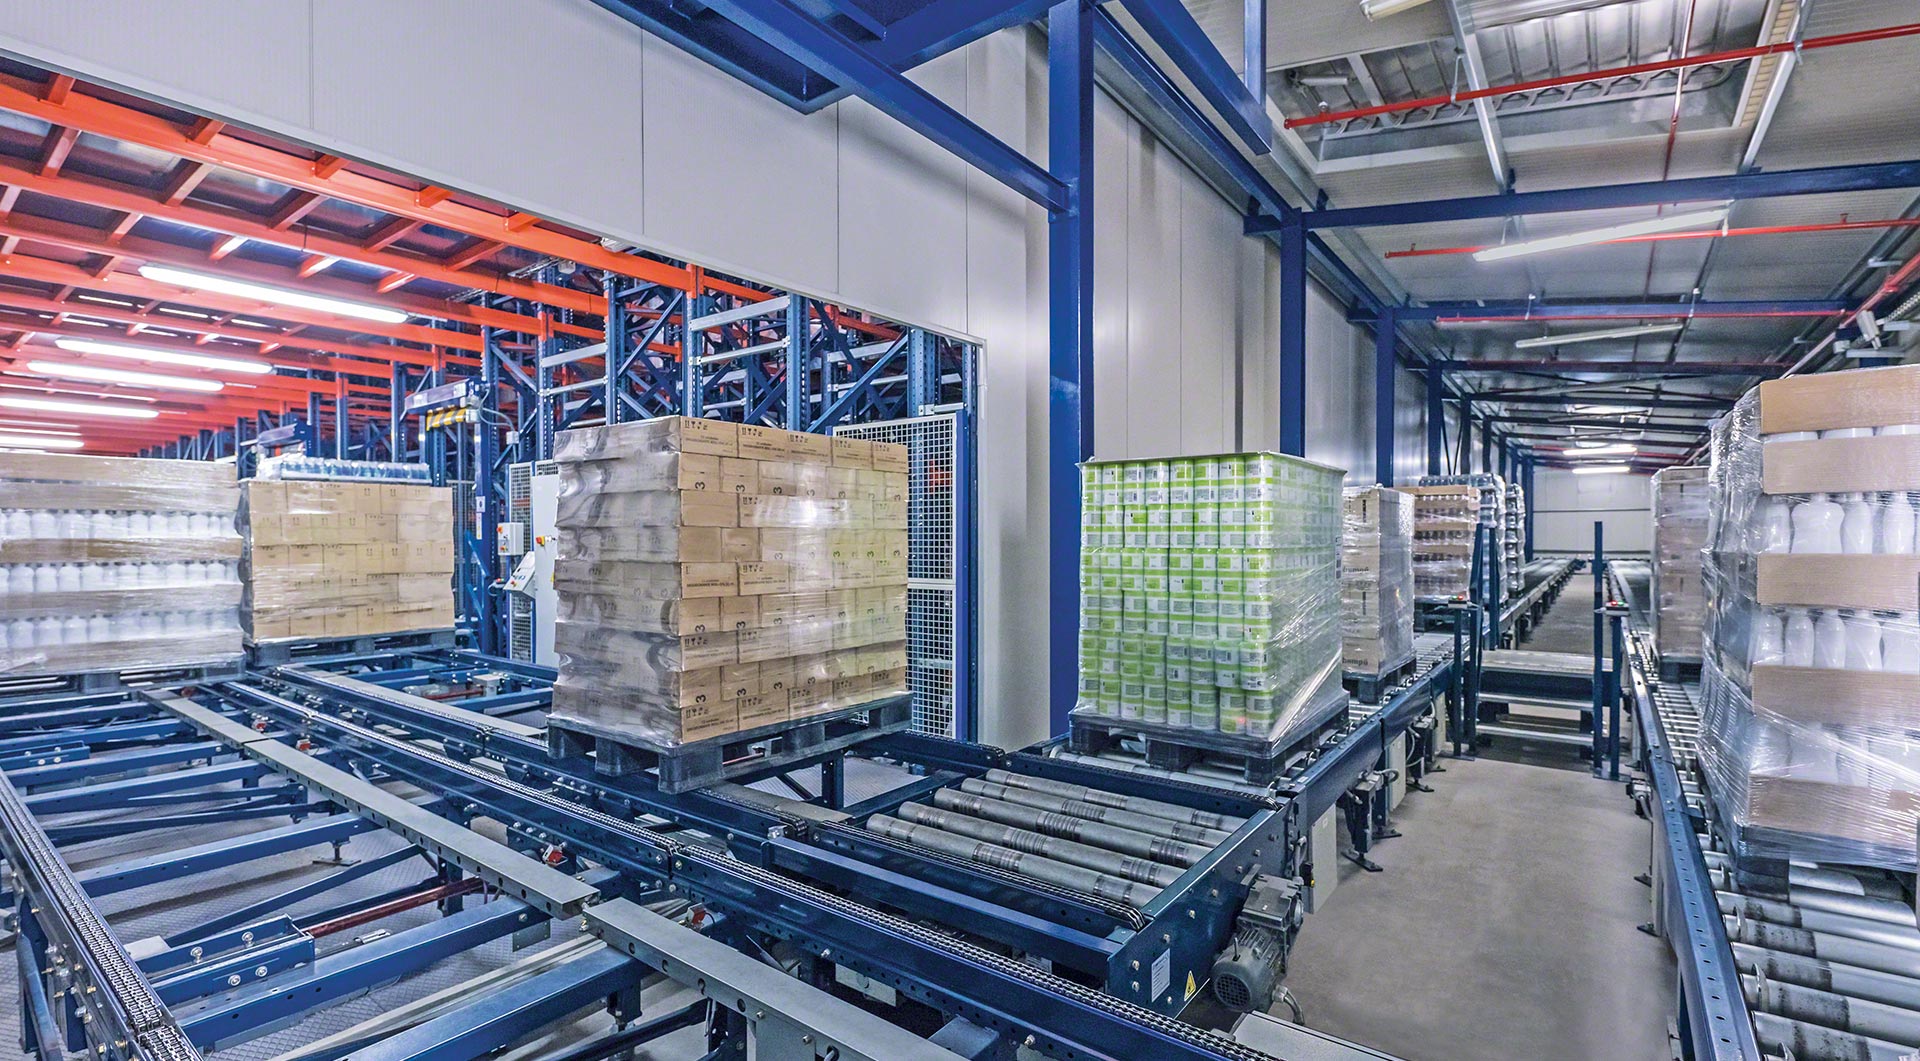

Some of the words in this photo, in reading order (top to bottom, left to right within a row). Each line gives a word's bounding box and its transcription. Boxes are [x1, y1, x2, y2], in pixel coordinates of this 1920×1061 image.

[695, 481, 705, 490] 3
[736, 484, 745, 492] 3
[773, 486, 782, 494] 3
[695, 624, 705, 633] 3
[736, 621, 745, 629] 3
[774, 681, 783, 690] 3
[737, 688, 746, 696] 3
[695, 694, 706, 703] 3
